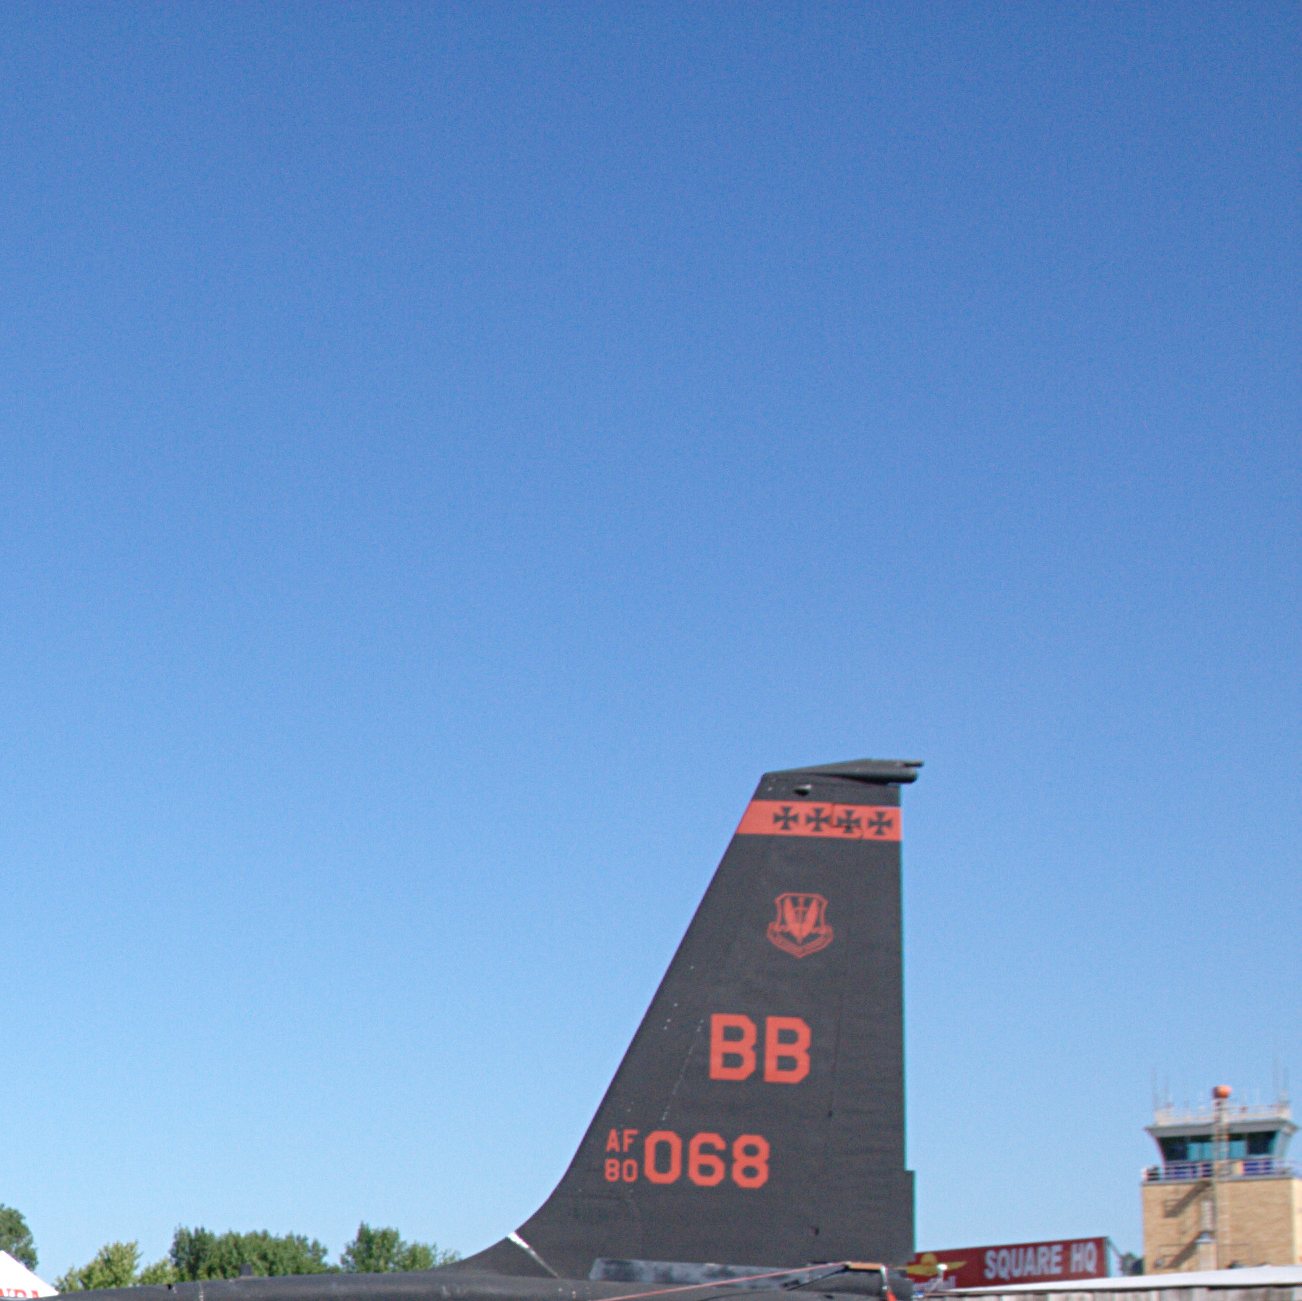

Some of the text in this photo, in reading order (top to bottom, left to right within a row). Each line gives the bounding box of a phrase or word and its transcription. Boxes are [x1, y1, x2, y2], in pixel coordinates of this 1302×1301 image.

[709, 1013, 812, 1085] BB
[605, 1128, 639, 1153] AF
[644, 1130, 771, 1189] 068
[604, 1158, 639, 1183] 80
[984, 1241, 1098, 1280] SQUARE HQ
